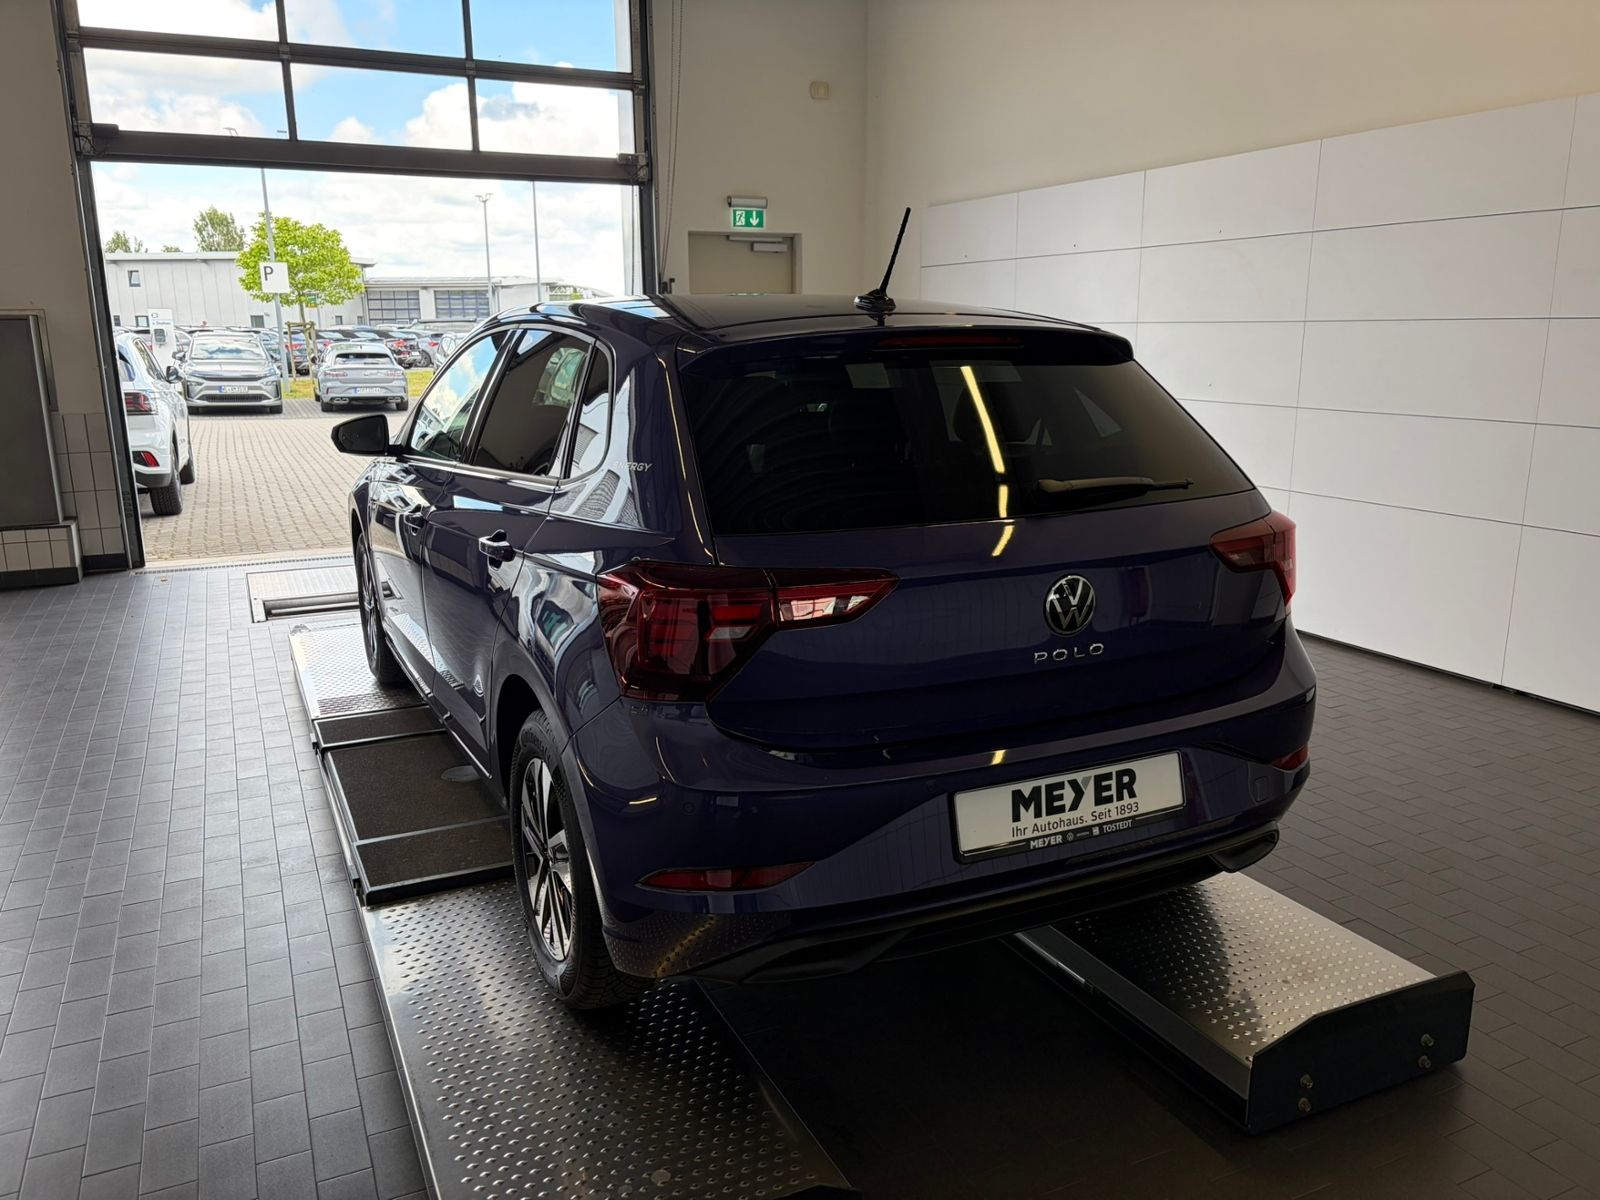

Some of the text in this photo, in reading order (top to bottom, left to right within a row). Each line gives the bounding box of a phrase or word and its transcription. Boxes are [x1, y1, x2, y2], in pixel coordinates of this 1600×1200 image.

[263, 265, 274, 281] P
[1034, 642, 1104, 664] POLO
[1012, 768, 1137, 823] MEYER
[1012, 826, 1028, 838] Ihr
[1031, 816, 1088, 835] Autohaus.
[1091, 808, 1112, 821] Seit
[1115, 801, 1139, 816] 1893
[1030, 834, 1063, 849] MEYER
[1102, 820, 1133, 833] TOSTEDT
